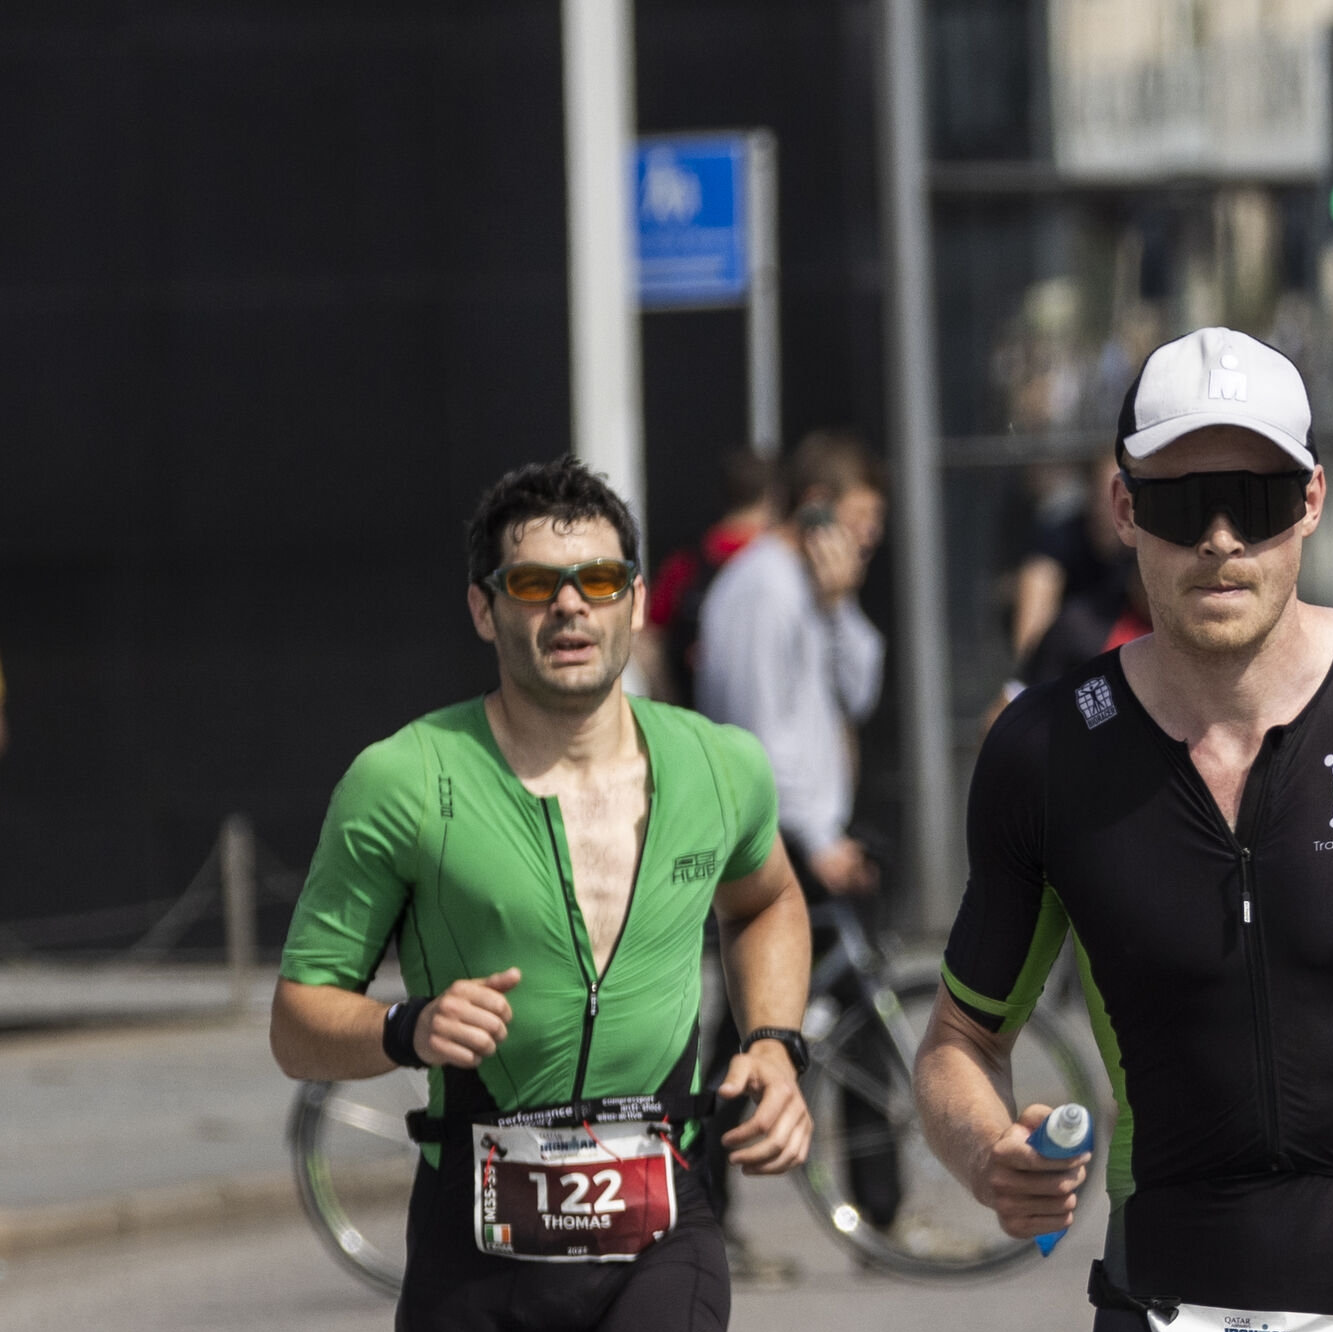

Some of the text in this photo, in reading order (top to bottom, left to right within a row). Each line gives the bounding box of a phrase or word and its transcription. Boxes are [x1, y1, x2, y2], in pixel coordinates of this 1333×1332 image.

[498, 1106, 574, 1126] performance
[528, 1169, 626, 1214] 122
[542, 1214, 612, 1231] THOMAS
[1224, 1316, 1251, 1325] QATAR
